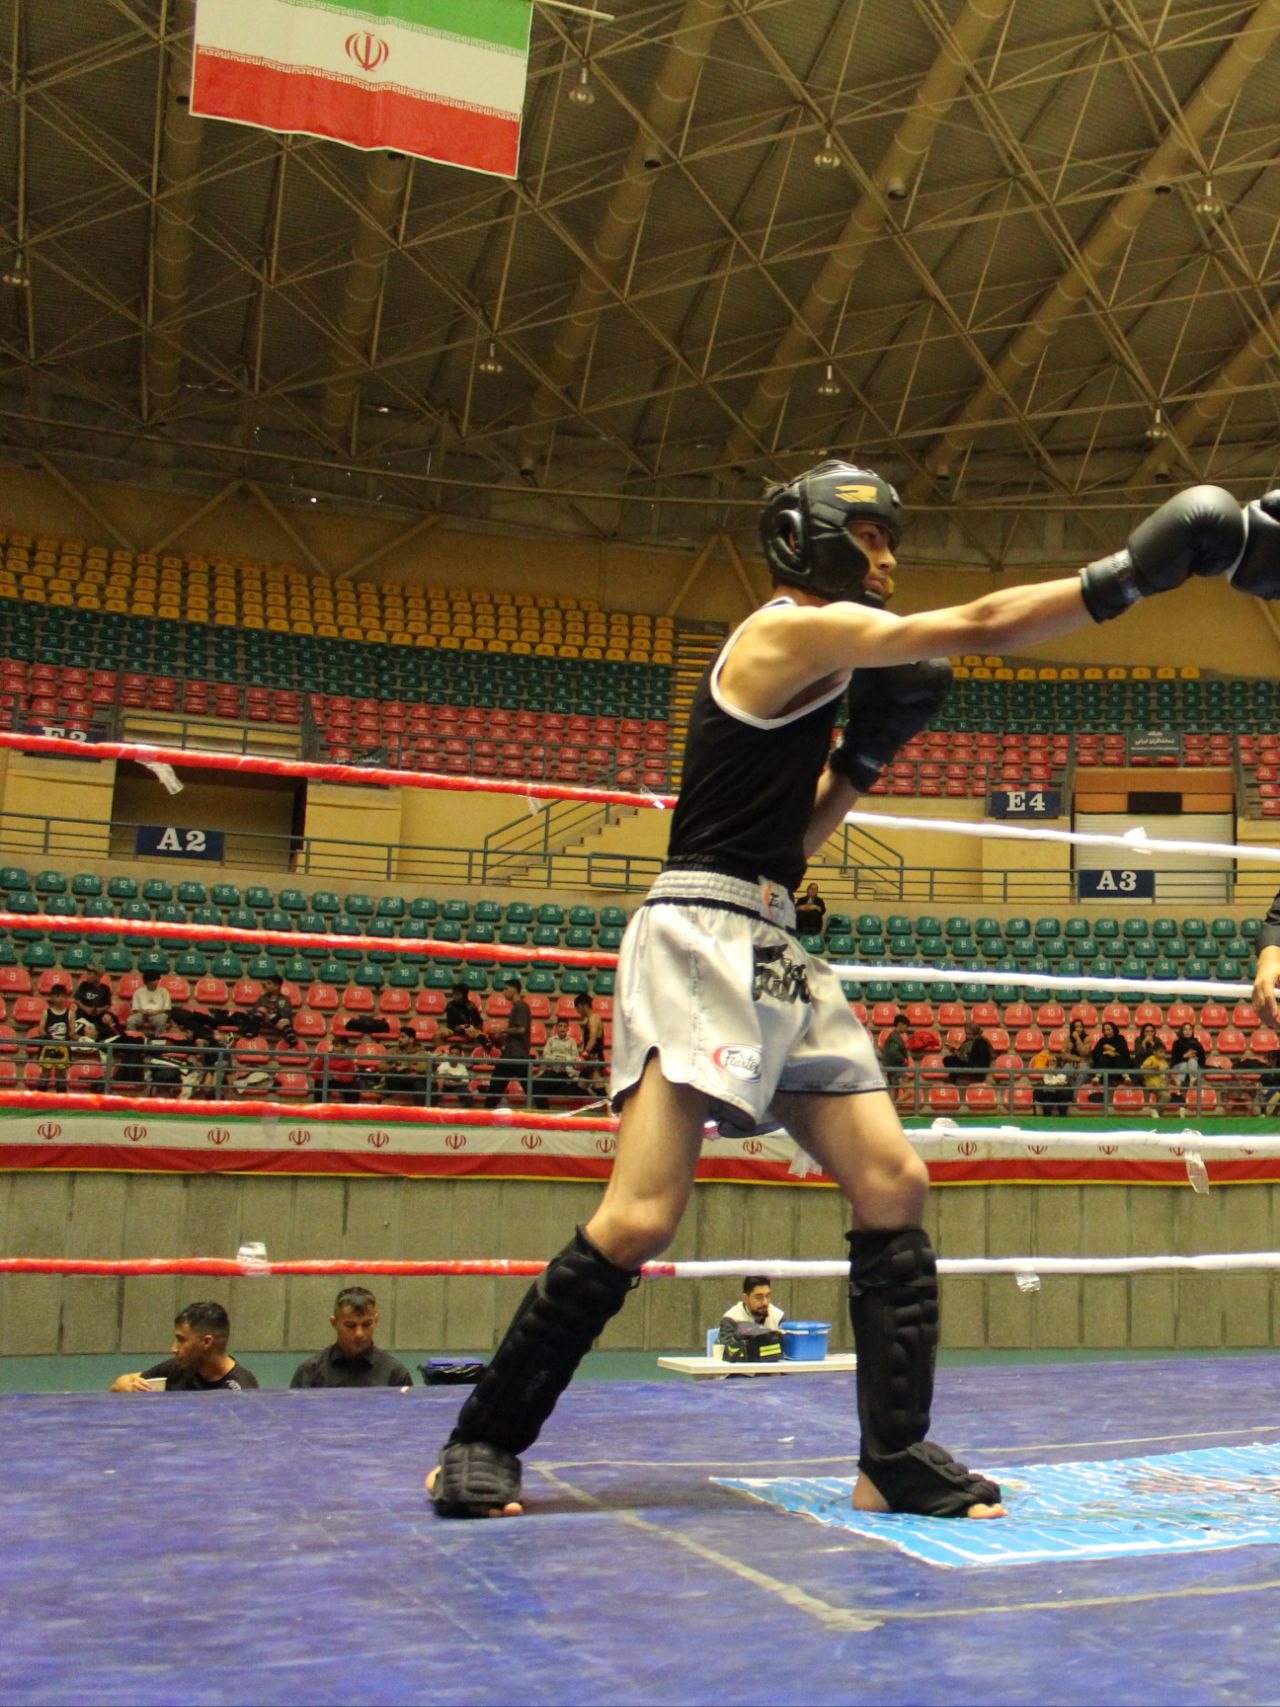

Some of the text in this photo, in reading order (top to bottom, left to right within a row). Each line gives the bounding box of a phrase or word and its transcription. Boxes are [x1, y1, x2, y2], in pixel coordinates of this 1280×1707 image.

[1006, 791, 1046, 811] E4
[156, 827, 207, 852] A2
[1096, 870, 1137, 891] A3
